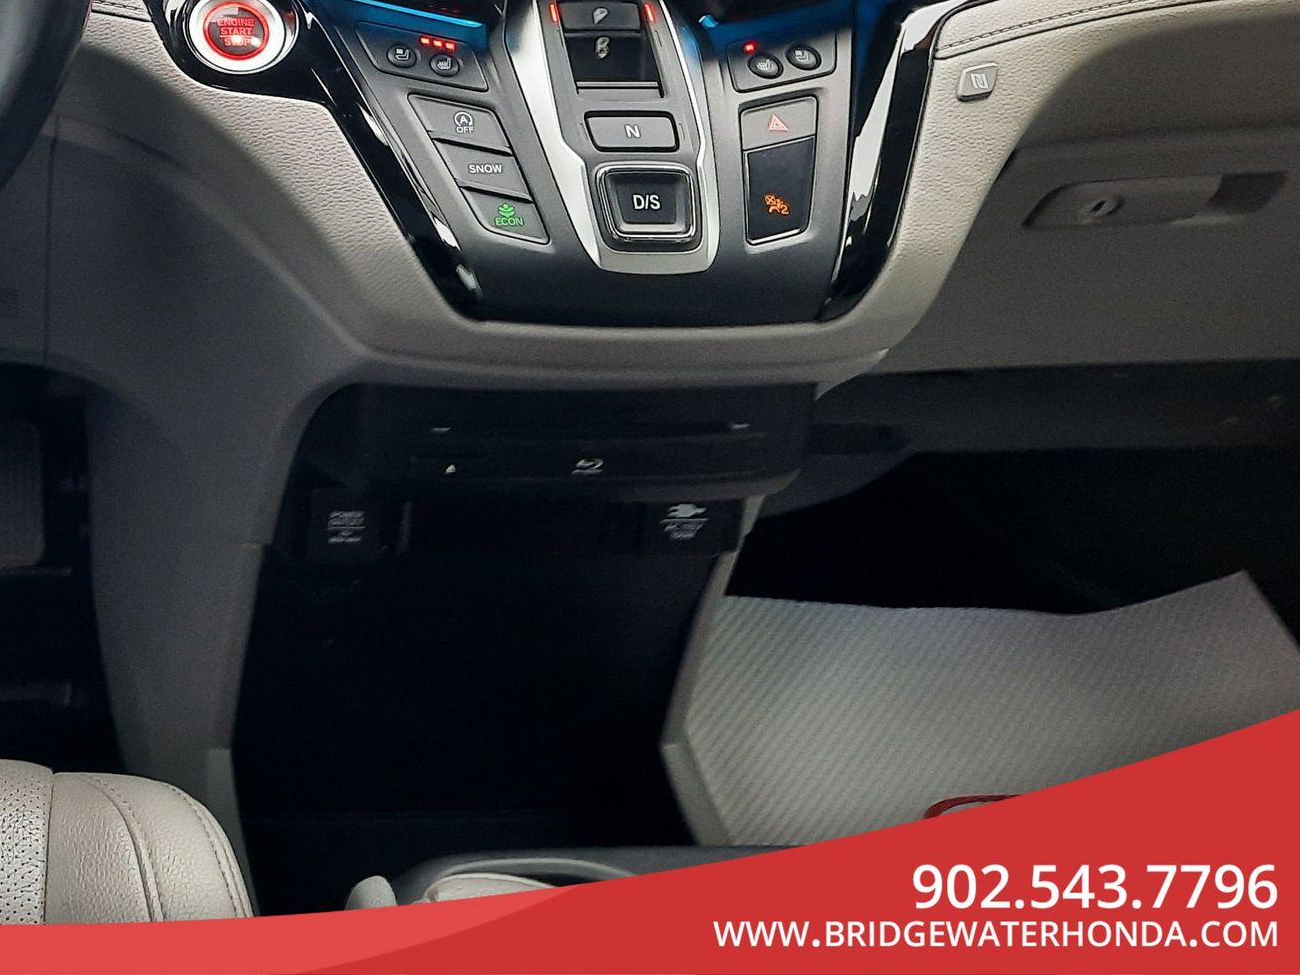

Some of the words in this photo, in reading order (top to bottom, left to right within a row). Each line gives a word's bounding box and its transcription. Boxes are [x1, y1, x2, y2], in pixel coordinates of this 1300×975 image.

[216, 18, 255, 27] ENGINE
[220, 27, 253, 35] START
[456, 125, 474, 134] OFF
[625, 124, 640, 138] N
[468, 164, 502, 174] SNOW
[632, 194, 661, 210] D/S
[495, 216, 523, 227] ECON
